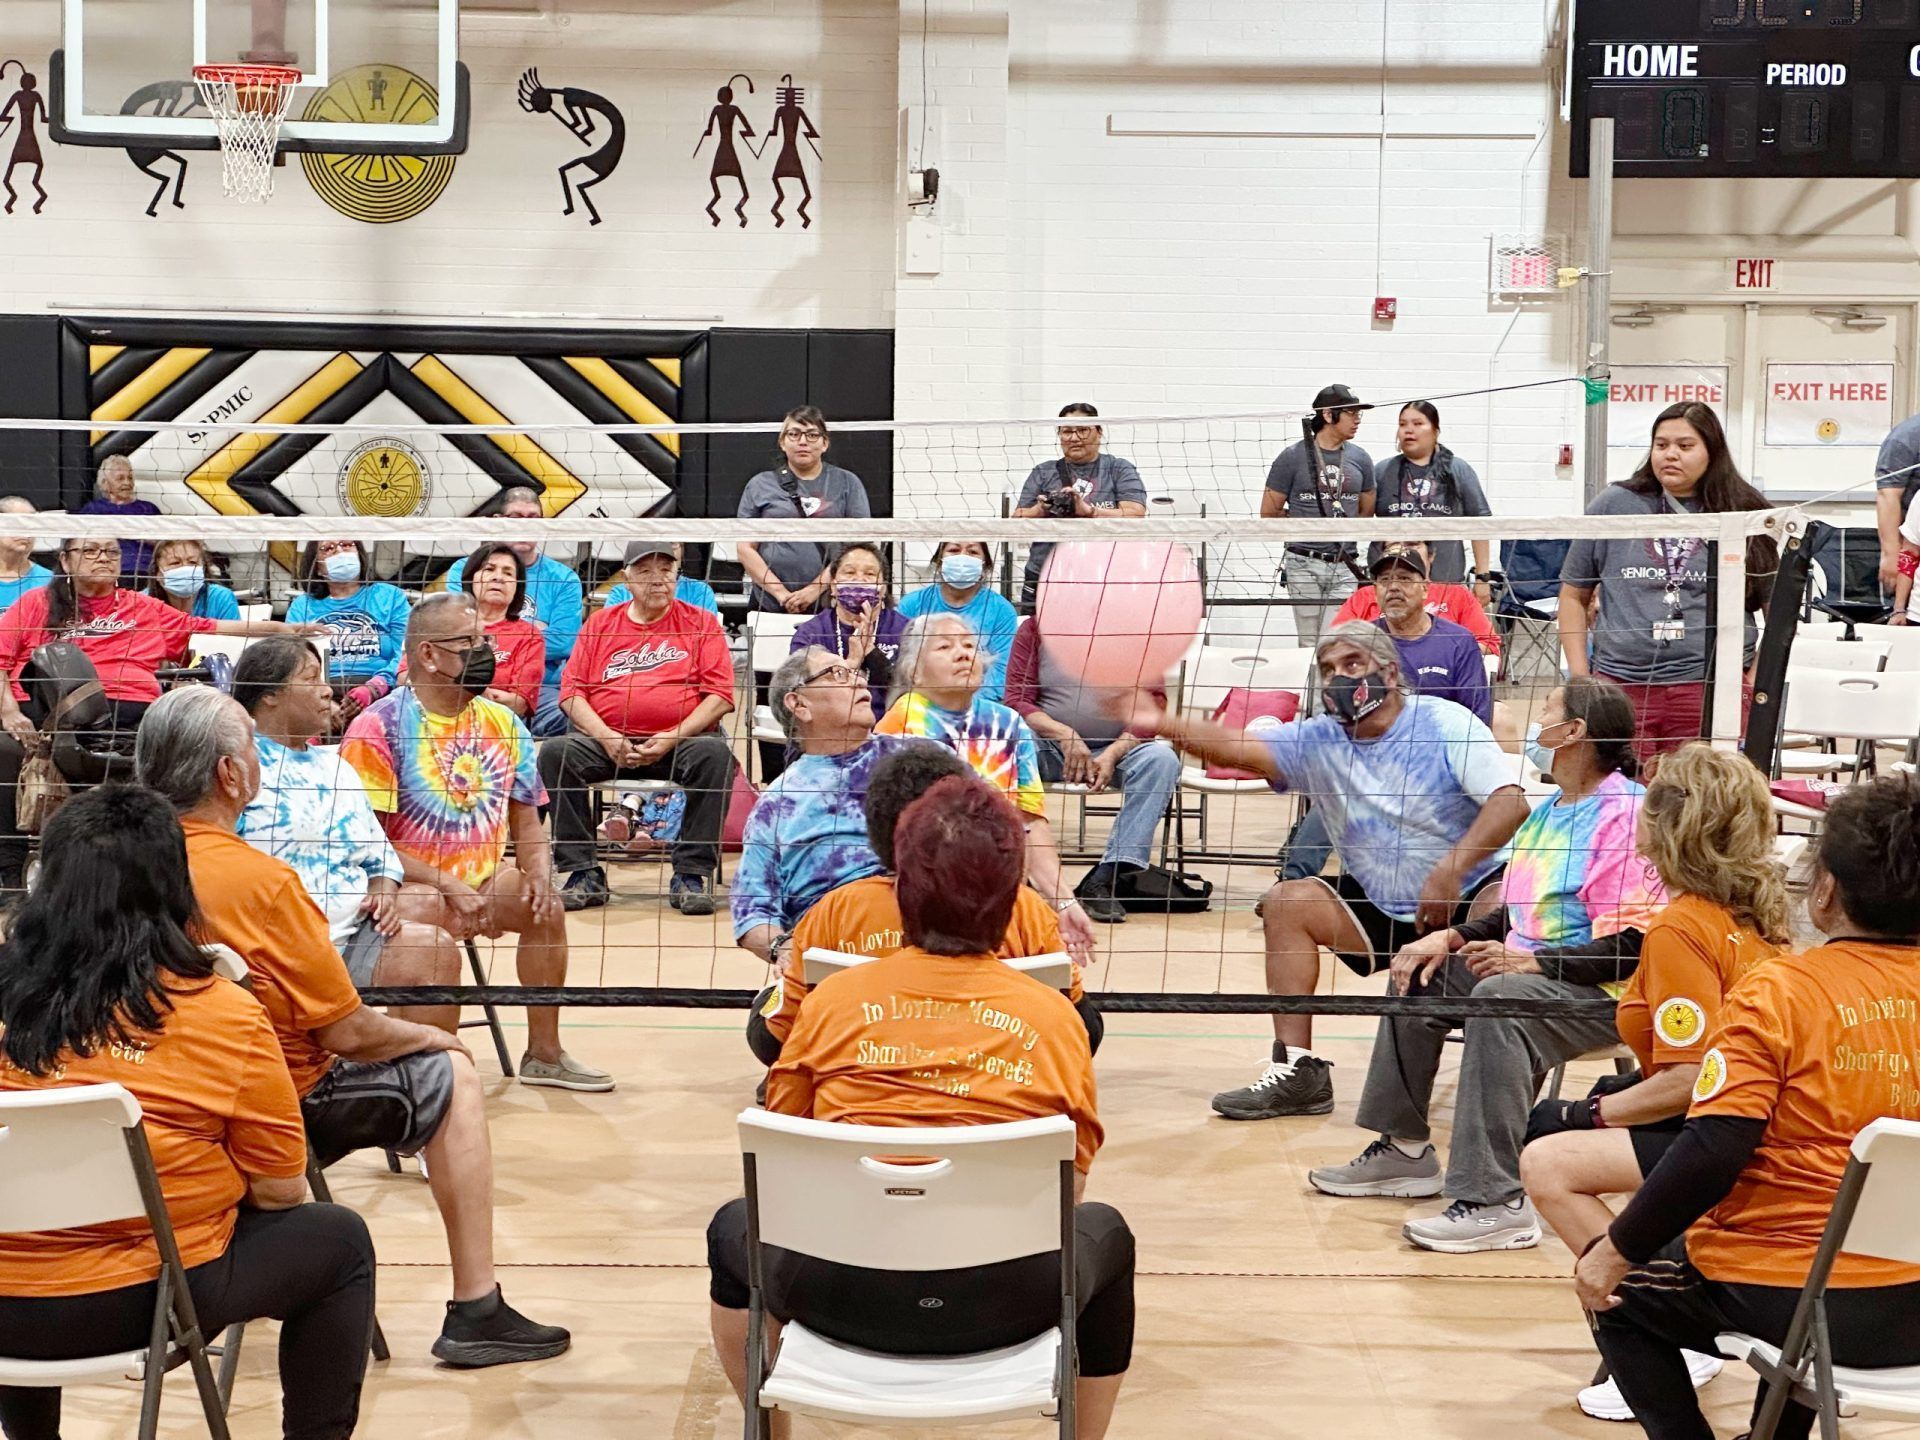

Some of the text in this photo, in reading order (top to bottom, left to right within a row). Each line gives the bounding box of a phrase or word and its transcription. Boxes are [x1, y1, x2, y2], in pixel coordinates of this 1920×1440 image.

[1603, 44, 1699, 77] HOME
[1766, 63, 1847, 86] PERIOD
[1736, 259, 1774, 288] EXIT
[1610, 384, 1722, 402] EXIT HERE
[1775, 383, 1888, 401] EXIT HERE
[1299, 492, 1331, 501] SENOR
[1621, 567, 1667, 580] SENIOR
[608, 639, 678, 669] Soboba
[860, 928, 904, 953] Lovin
[861, 1001, 885, 1026] In
[967, 999, 1041, 1052] Memory
[1836, 1003, 1860, 1029] In
